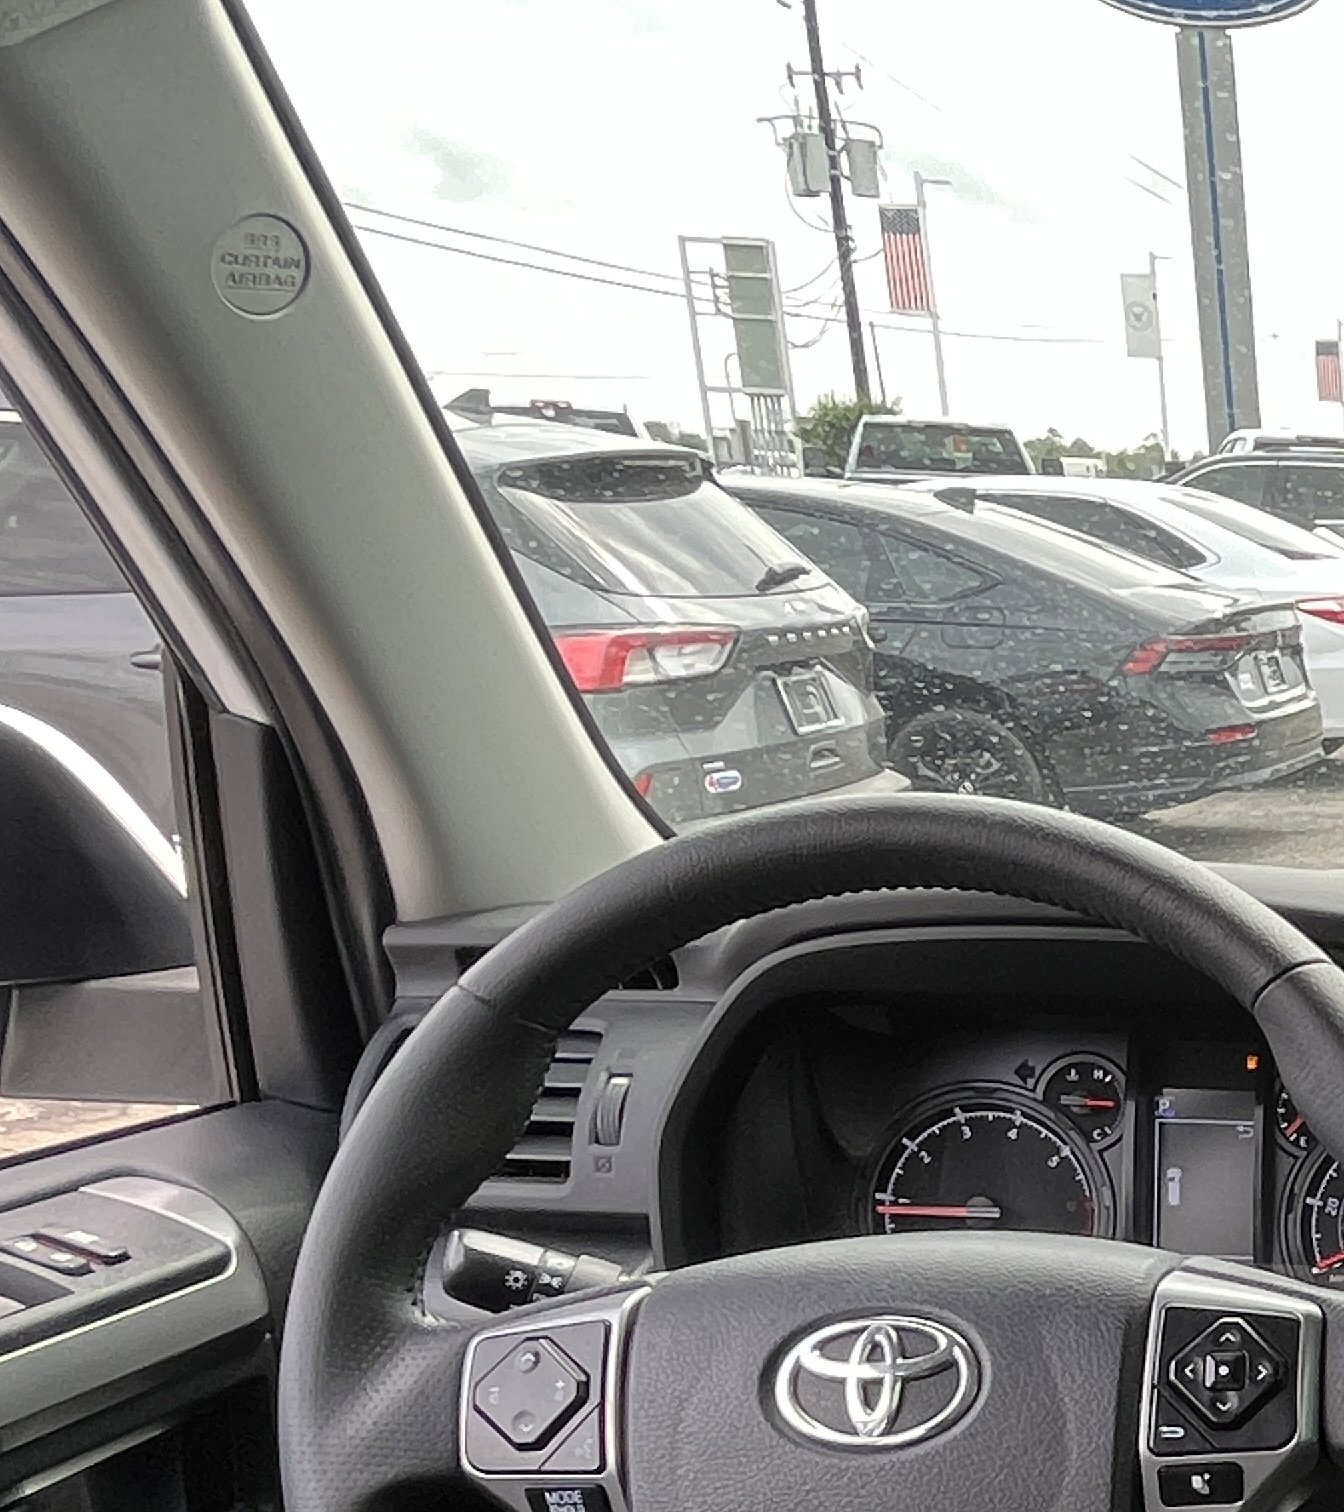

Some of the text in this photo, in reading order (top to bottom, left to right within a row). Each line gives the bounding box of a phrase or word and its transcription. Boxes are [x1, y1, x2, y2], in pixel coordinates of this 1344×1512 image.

[961, 1126, 972, 1140] 3
[1007, 1127, 1018, 1140] 4
[918, 1151, 932, 1164] 2
[1325, 1197, 1340, 1216] 20
[545, 1487, 584, 1504] MODE
